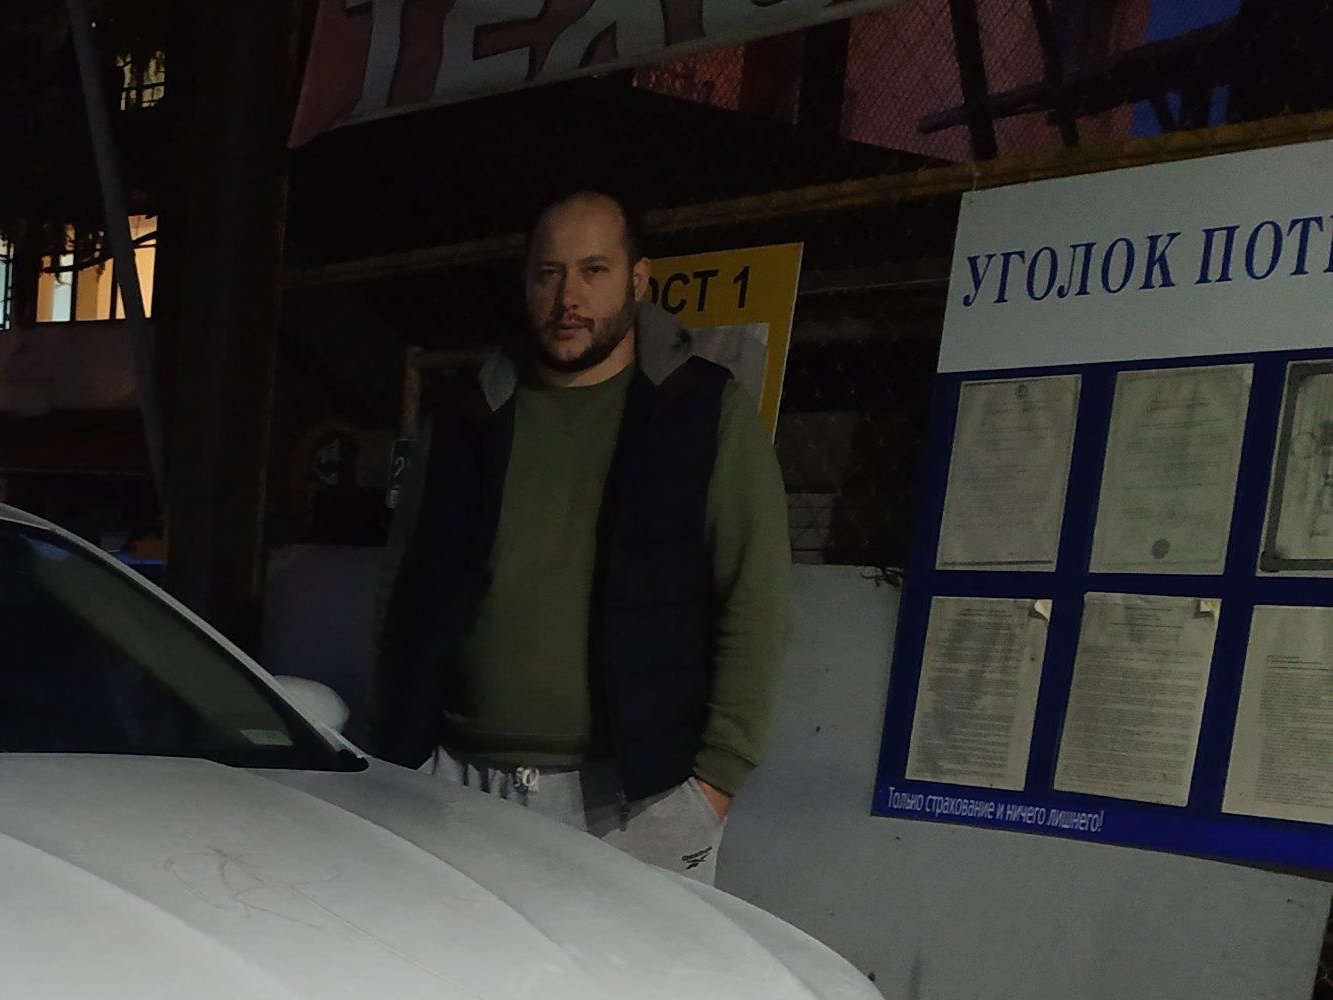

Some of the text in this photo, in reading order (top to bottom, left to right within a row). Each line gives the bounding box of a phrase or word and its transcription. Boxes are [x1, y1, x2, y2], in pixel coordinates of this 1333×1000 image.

[963, 215, 1333, 307] УГОЛОК ПОТ
[733, 265, 749, 309] 1
[888, 786, 1106, 833] Только страхование и ничего лишнего!
